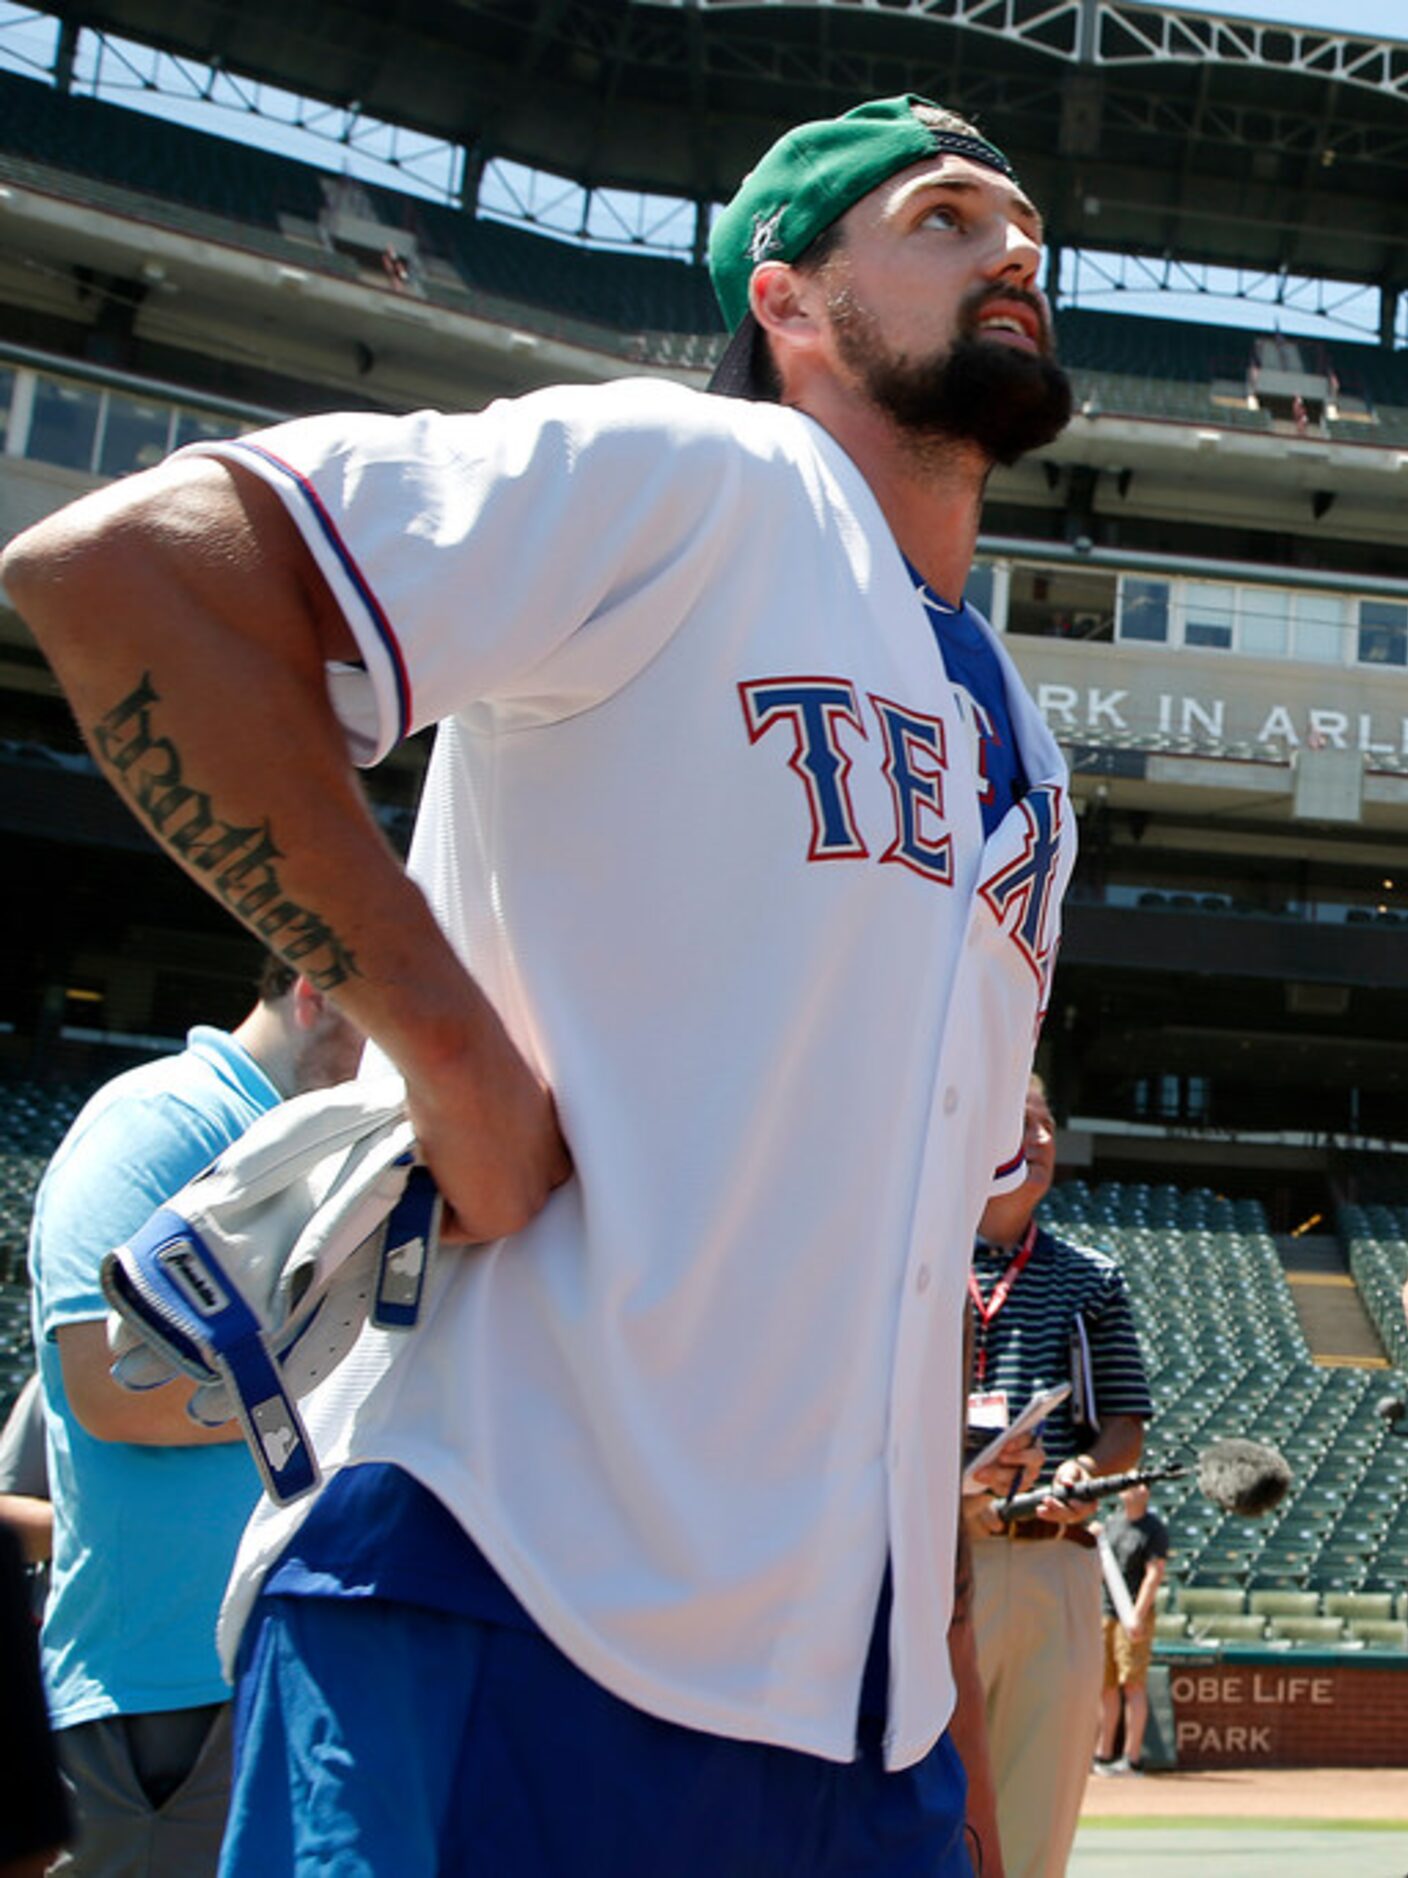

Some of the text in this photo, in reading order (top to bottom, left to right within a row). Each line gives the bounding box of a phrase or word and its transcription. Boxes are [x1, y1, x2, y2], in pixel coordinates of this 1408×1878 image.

[1157, 693, 1225, 739] IN
[736, 674, 1064, 1000] TEX
[1171, 1673, 1335, 1704] OBE LIFE
[1176, 1721, 1273, 1753] PARK
